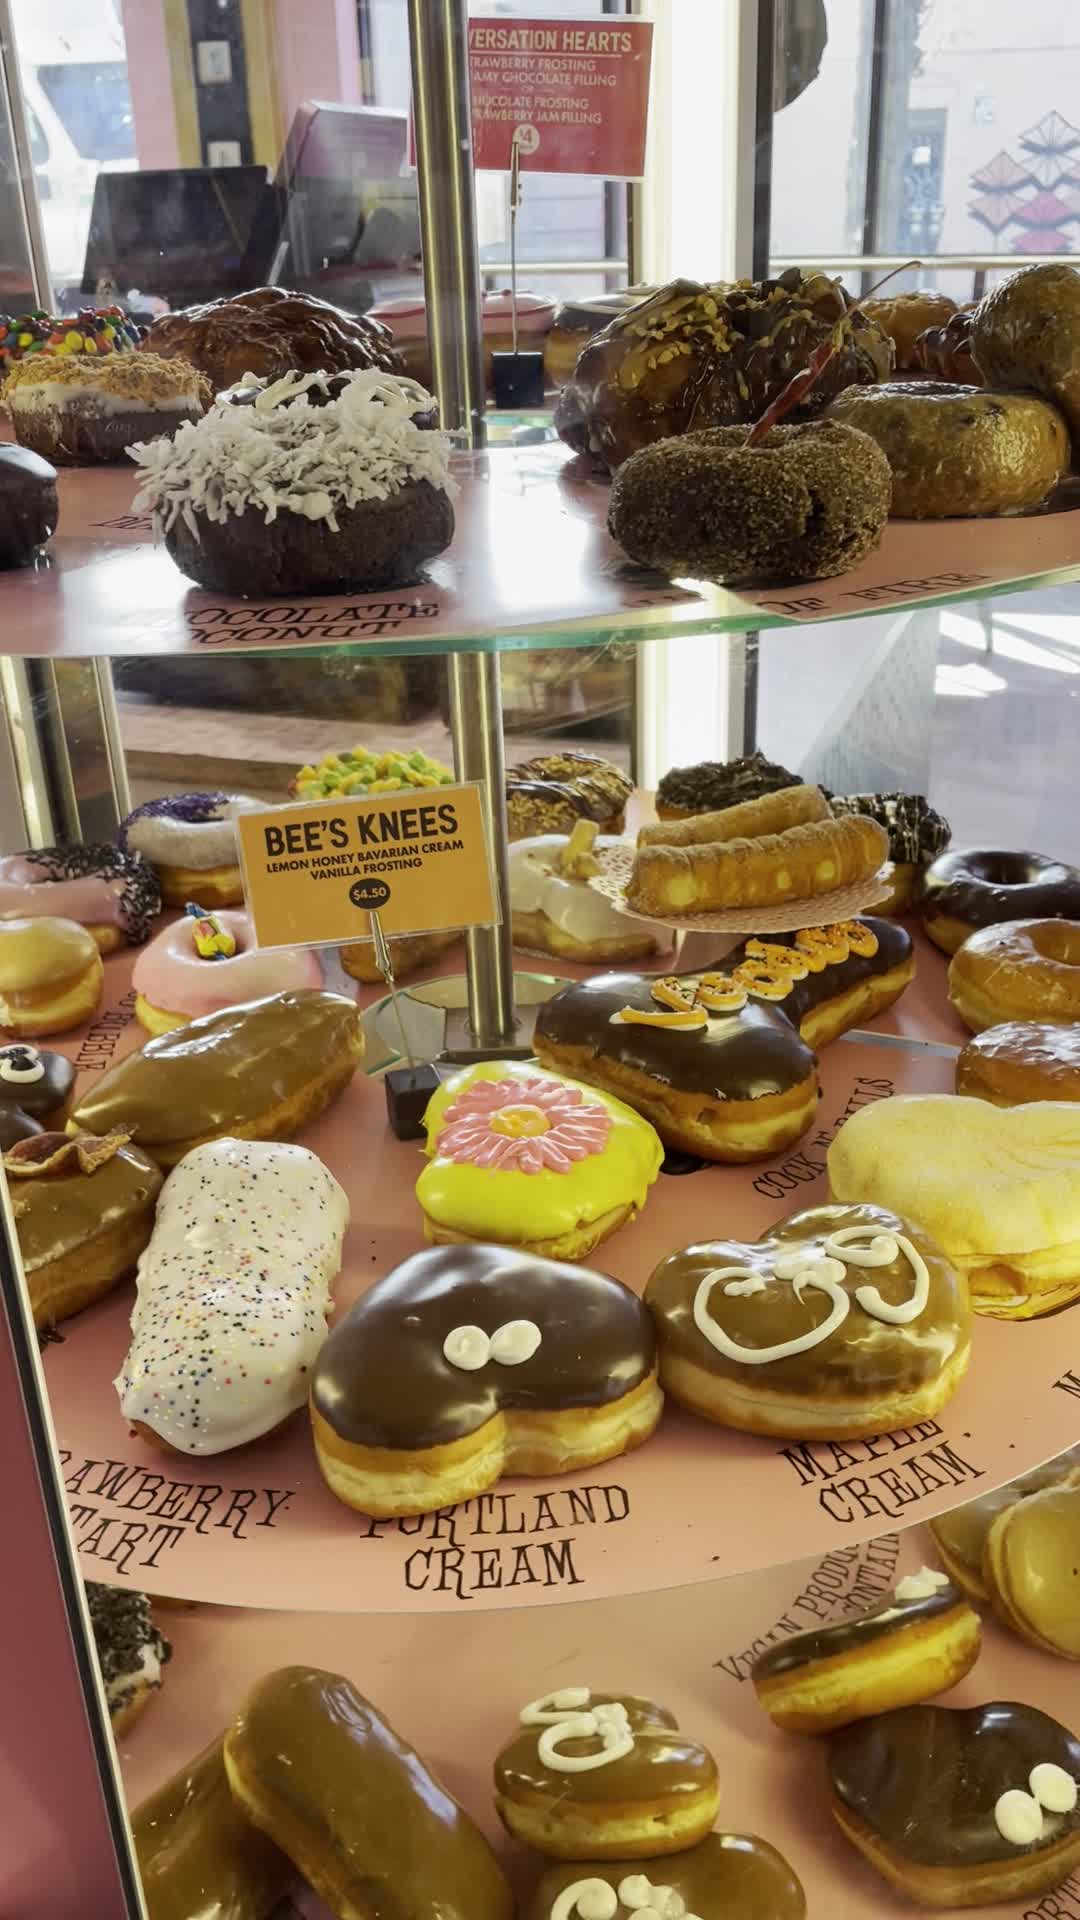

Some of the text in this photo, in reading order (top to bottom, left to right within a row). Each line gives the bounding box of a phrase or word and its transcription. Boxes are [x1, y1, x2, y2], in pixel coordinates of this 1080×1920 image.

[470, 28, 632, 52] ERSATION HEARTS
[470, 56, 597, 71] TRAWBERRY FROSTING
[471, 71, 617, 87] AMY CHOCOLATE FILLING
[472, 109, 603, 124] RAWBERRY JAM FILLING
[534, 97, 589, 110] FROSTING
[184, 603, 440, 626] OCOLATE
[188, 620, 402, 644] CONUT
[264, 803, 459, 857] BEE'S KNEES
[266, 839, 465, 874] LEMON HONEY BAVARIAN CREAM
[310, 857, 424, 881] VANILLA FROSTING
[352, 885, 388, 902] $4.50
[751, 1152, 829, 1200] COCK
[776, 1419, 945, 1487] MAPLE
[58, 1449, 297, 1541] AWBERRY
[818, 1440, 987, 1523] CREAM
[69, 1504, 187, 1576] TART
[404, 1537, 586, 1600] CREAM
[792, 1543, 861, 1621] PRODU
